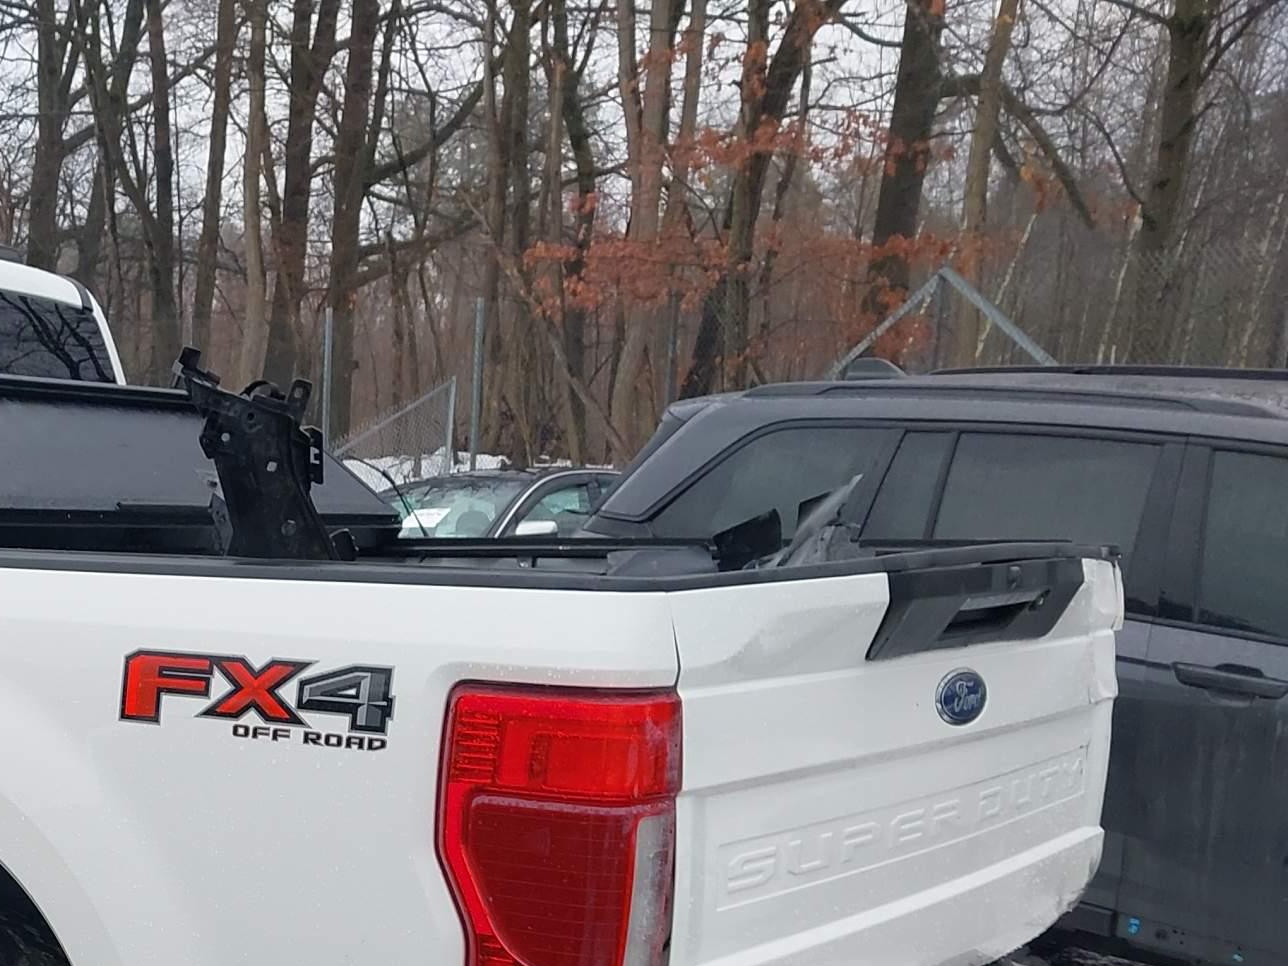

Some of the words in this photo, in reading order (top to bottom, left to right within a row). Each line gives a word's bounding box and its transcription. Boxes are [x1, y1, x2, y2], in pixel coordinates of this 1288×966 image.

[119, 648, 396, 735] FX4
[231, 723, 291, 742] OFF
[302, 731, 388, 751] ROAD
[725, 798, 963, 894] SUPER
[976, 756, 1085, 824] DUTY
